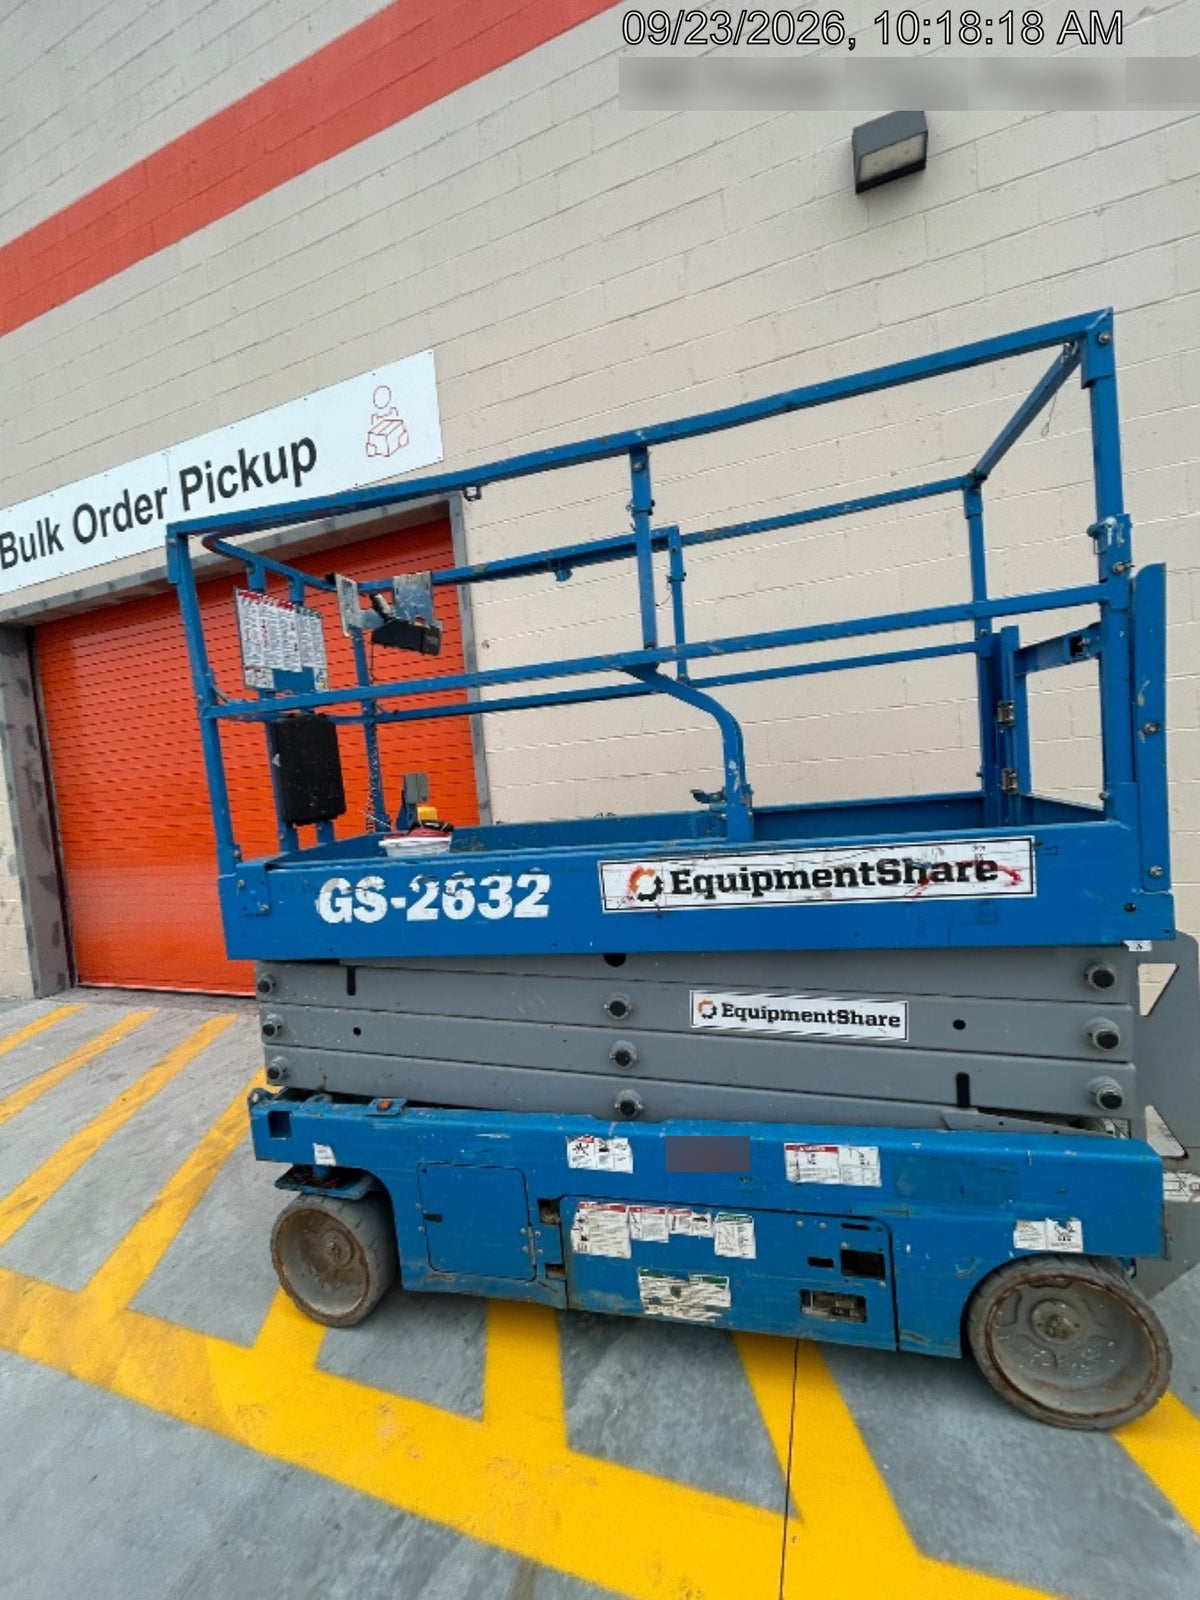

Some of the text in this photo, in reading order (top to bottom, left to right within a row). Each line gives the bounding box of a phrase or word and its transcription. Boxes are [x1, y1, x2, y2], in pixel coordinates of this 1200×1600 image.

[0, 437, 317, 569] Bulk Order Pickup
[315, 868, 550, 923] GS-2632
[670, 858, 999, 899] EquipmentShare
[721, 1003, 901, 1028] EquipmentShare
